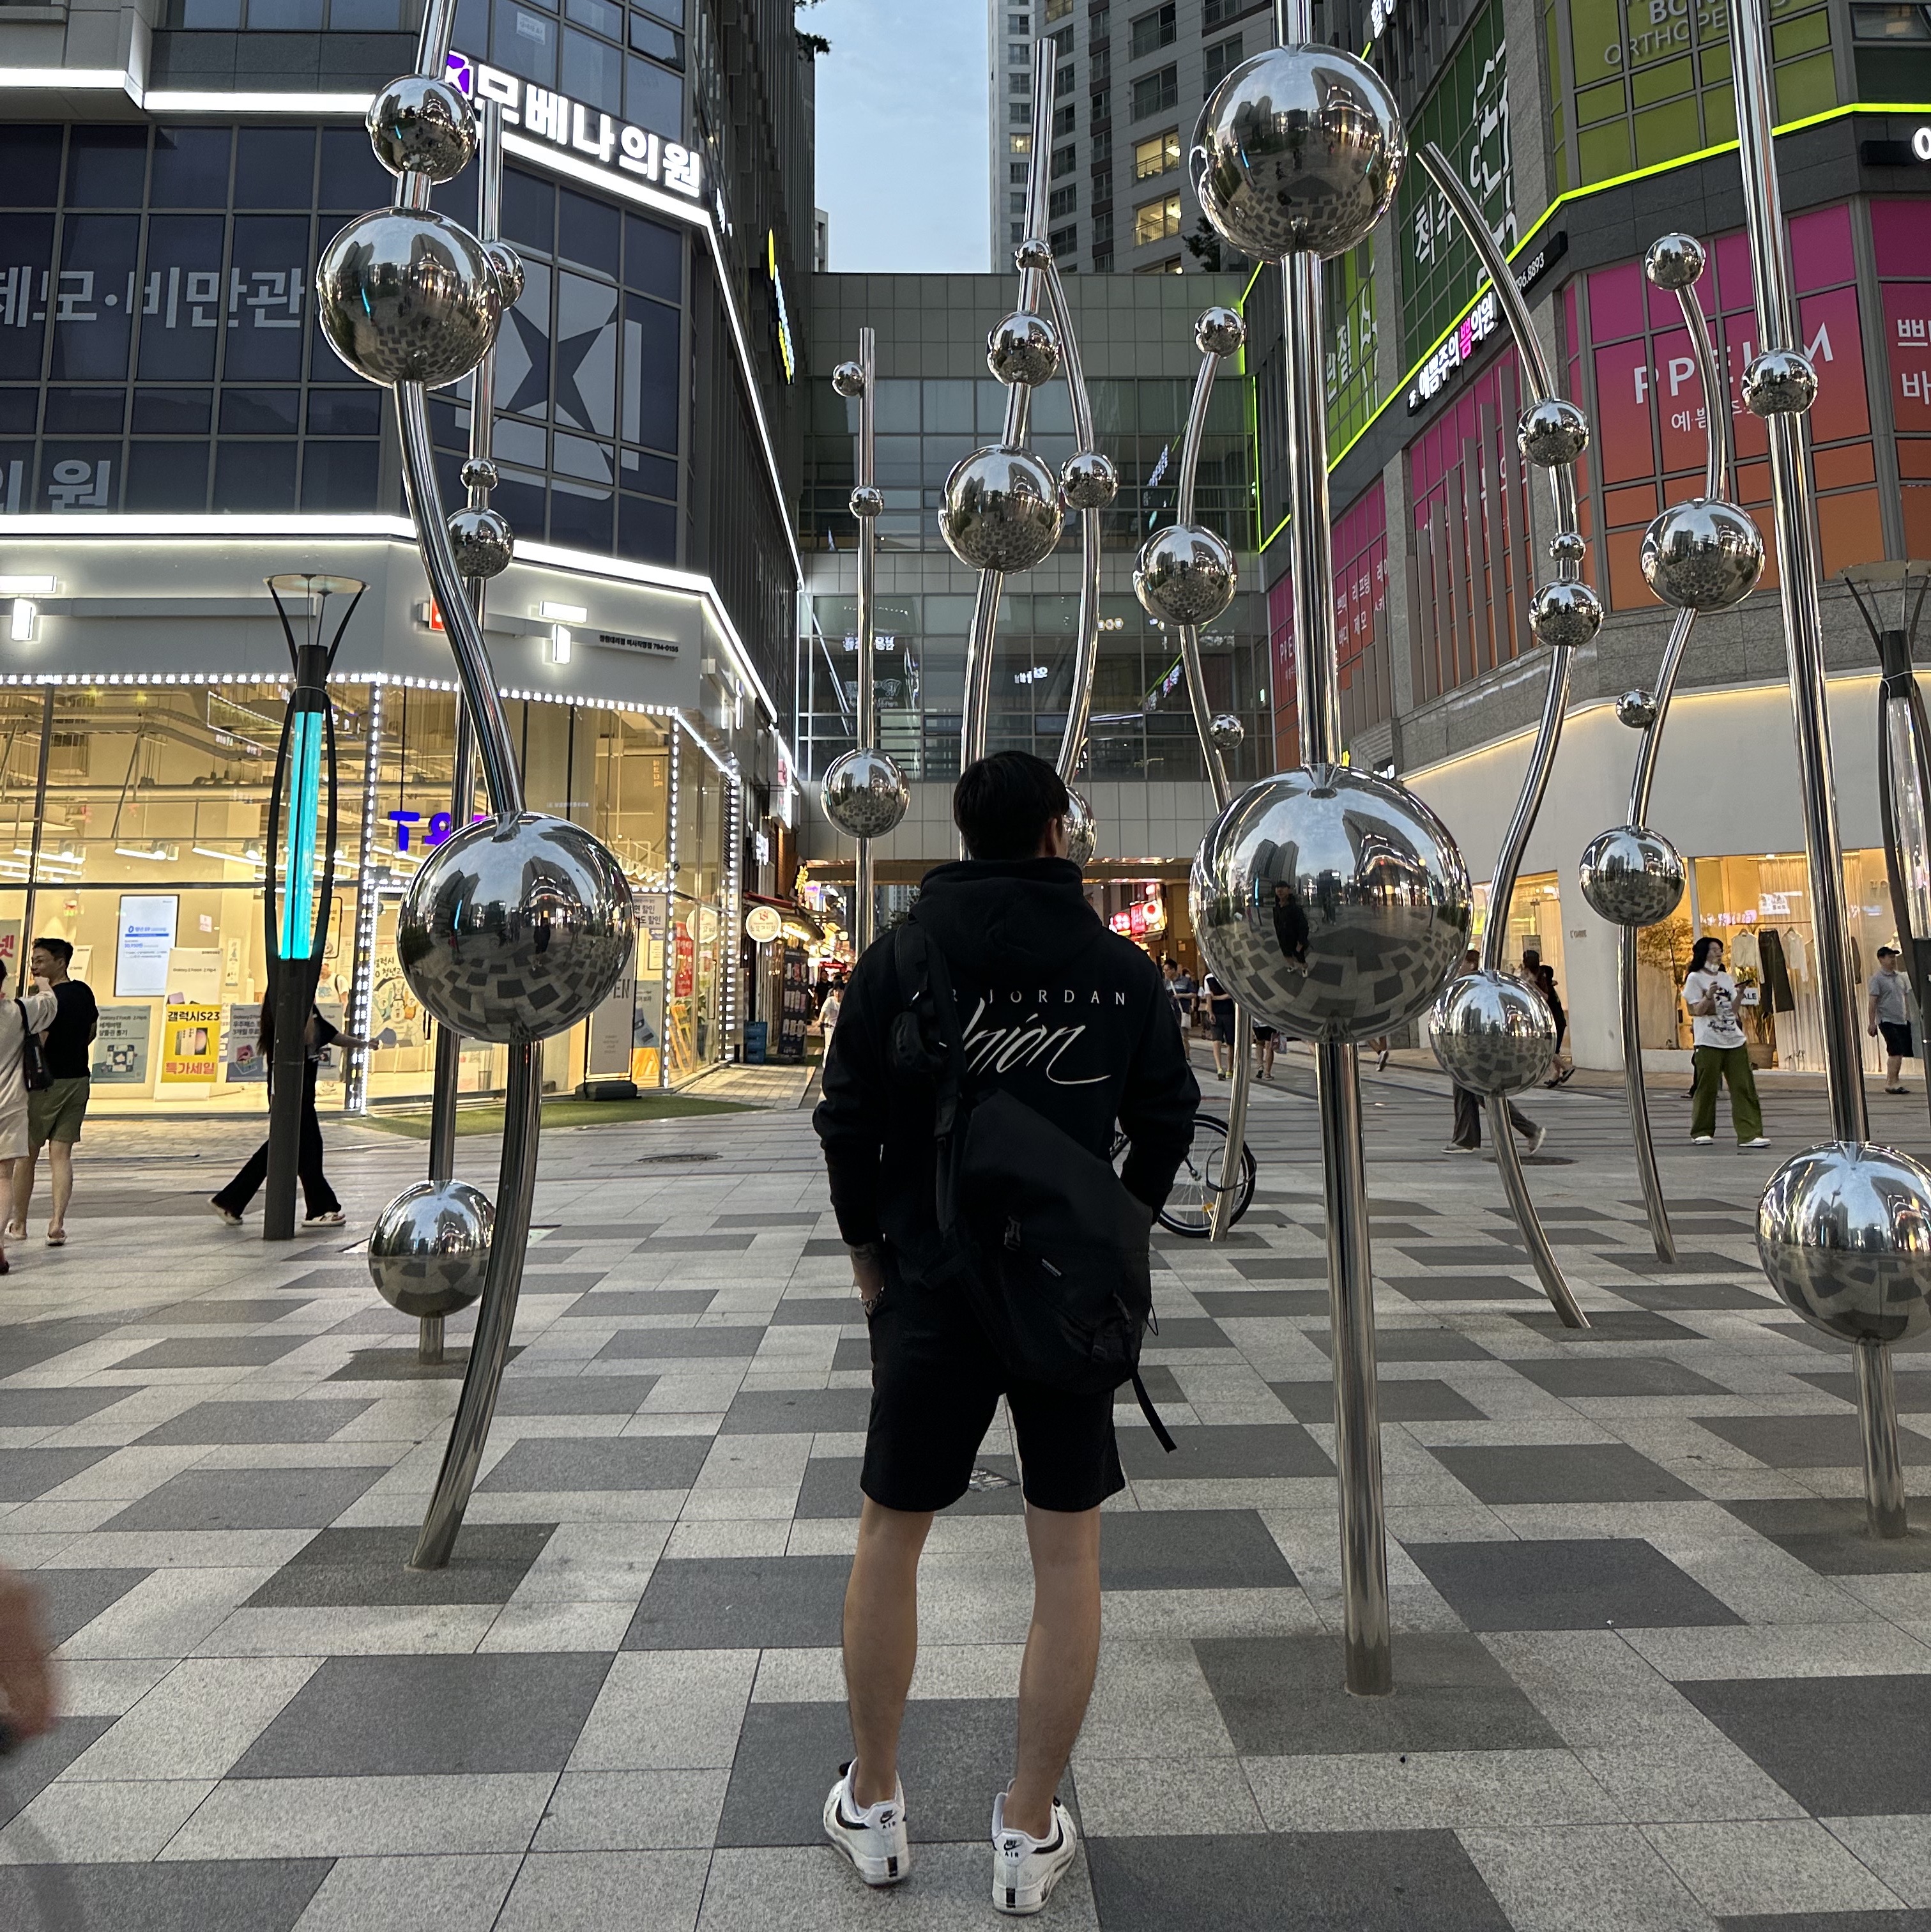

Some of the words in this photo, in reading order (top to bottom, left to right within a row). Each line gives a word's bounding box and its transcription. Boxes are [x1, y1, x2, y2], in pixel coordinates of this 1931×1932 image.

[1604, 0, 1786, 65] ORTHOPE
[474, 63, 701, 199] 모베나의원
[0, 266, 318, 328] 제모·비만관
[1897, 319, 1931, 347] 쁘
[613, 978, 630, 999] EN
[989, 989, 1125, 1006] JORDAN
[167, 1011, 220, 1022] 갤럭시S23
[165, 1062, 215, 1075] 특가세일
